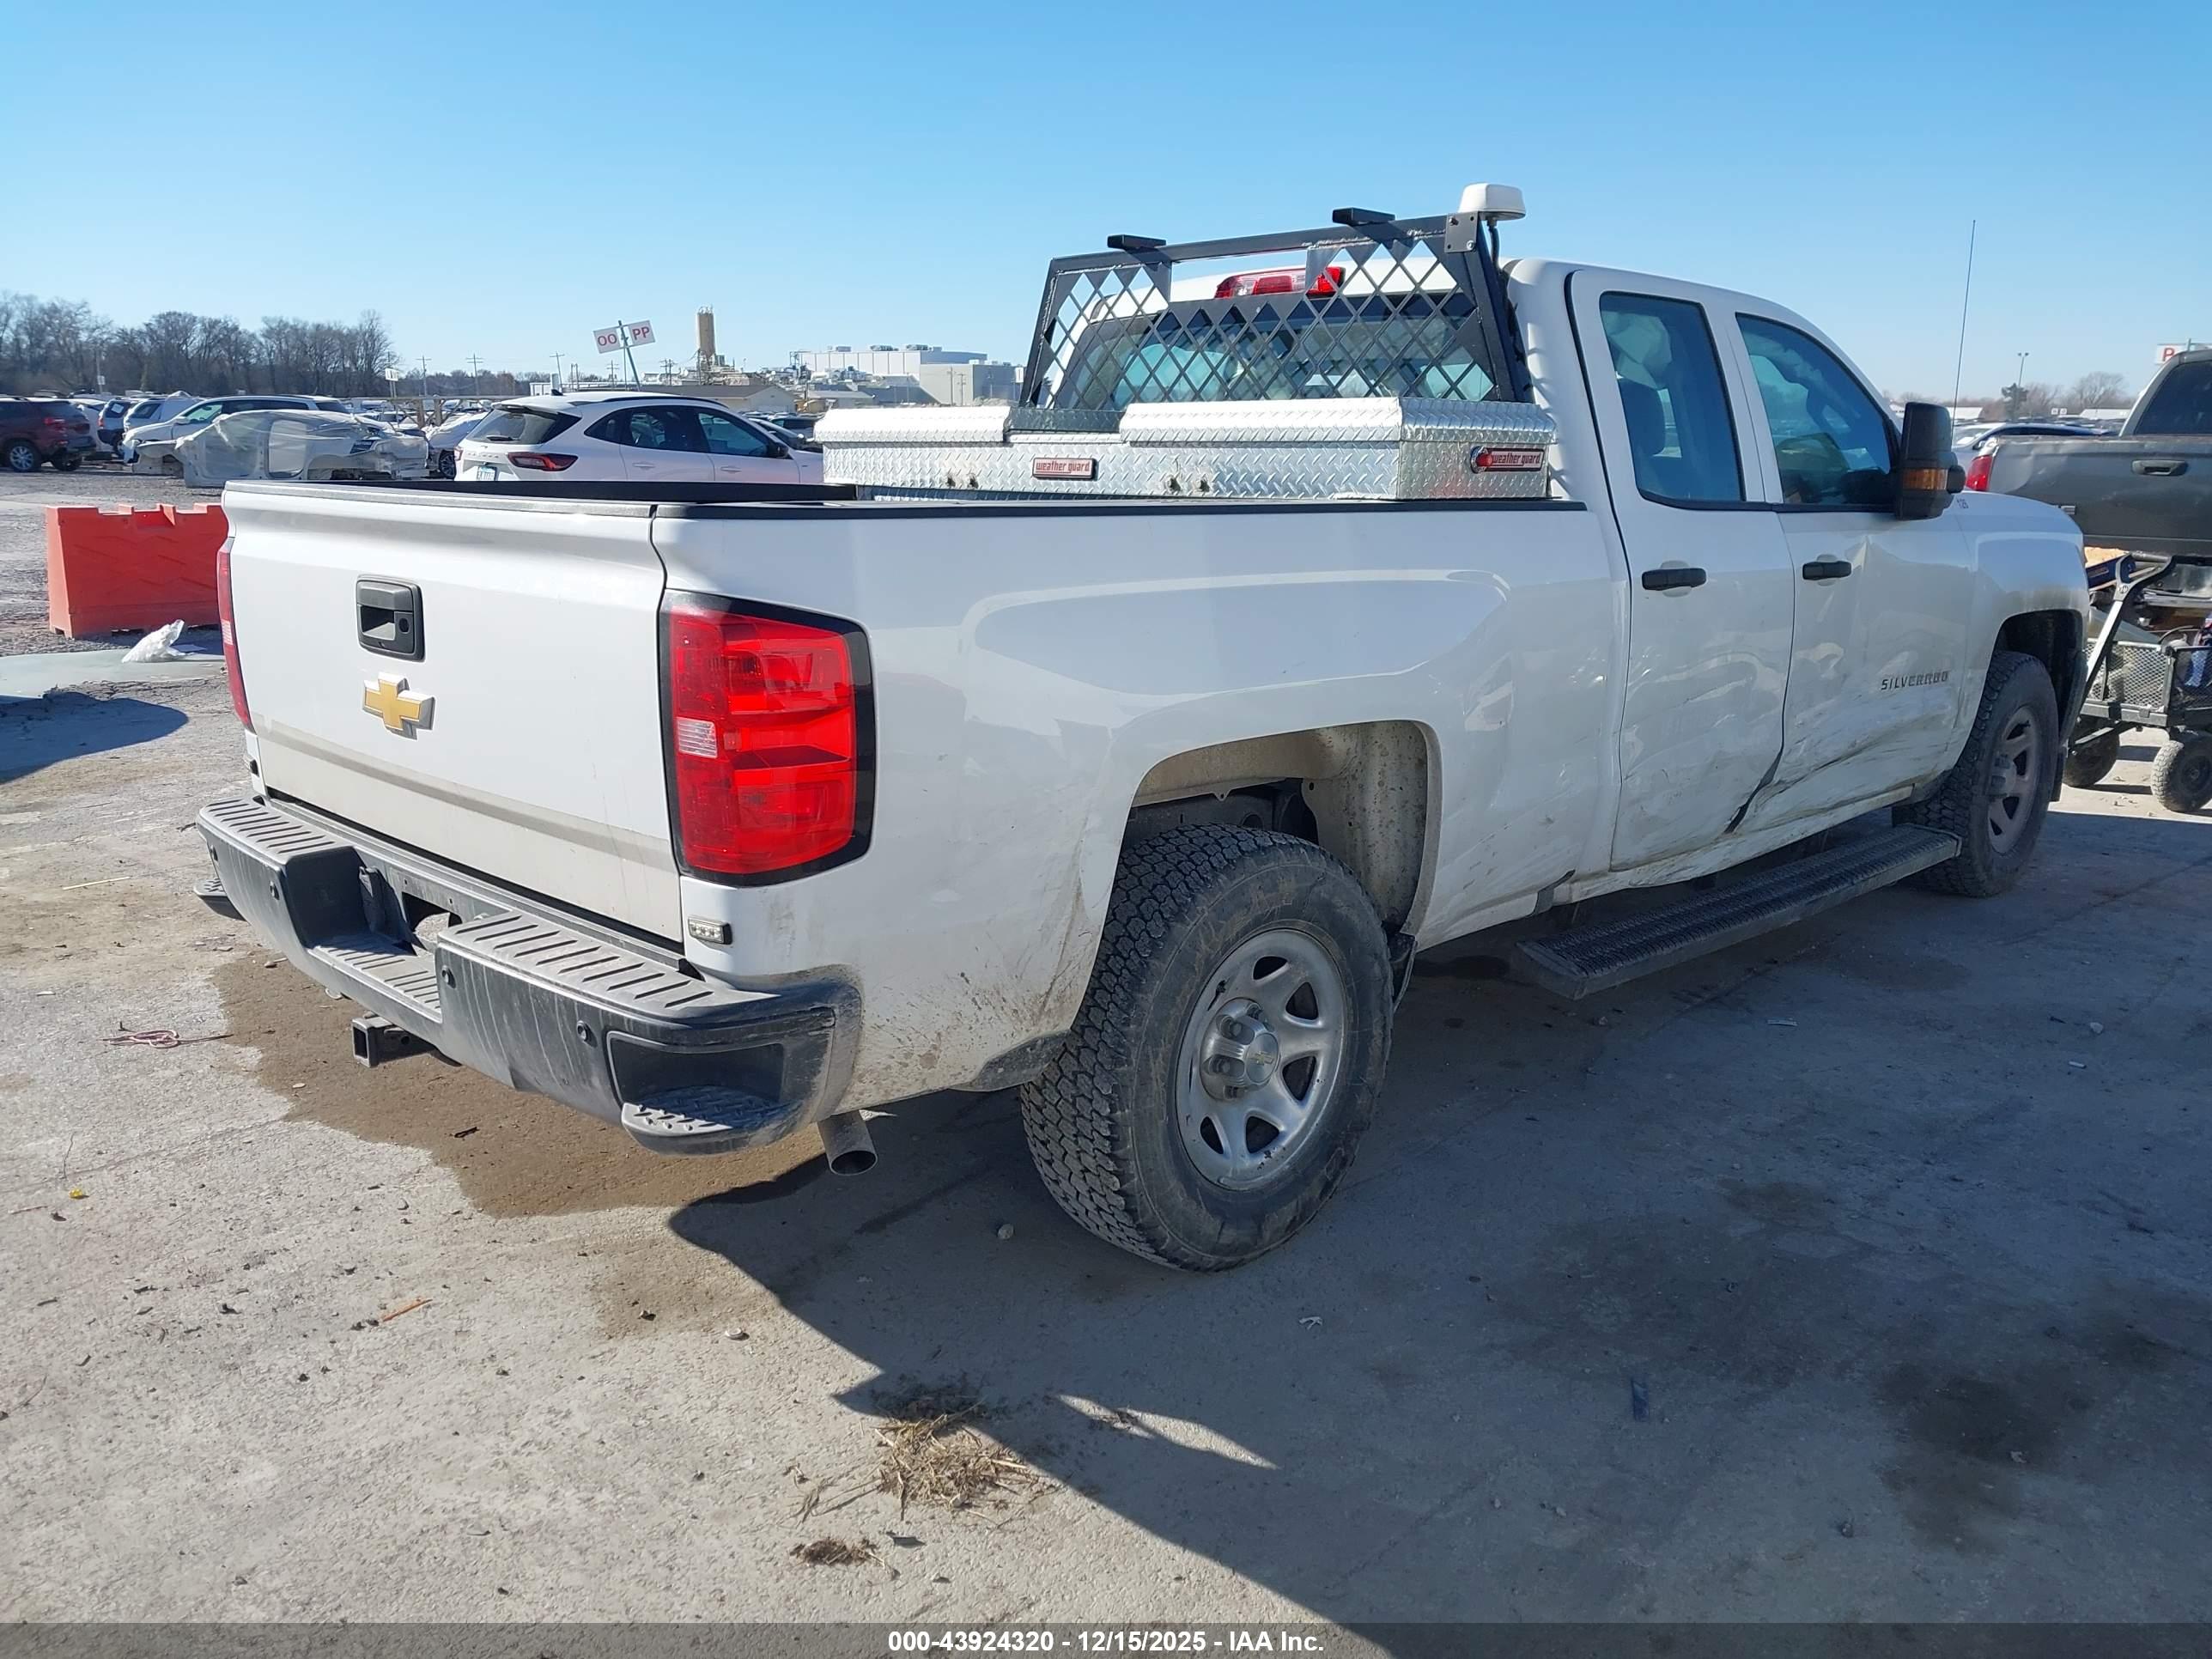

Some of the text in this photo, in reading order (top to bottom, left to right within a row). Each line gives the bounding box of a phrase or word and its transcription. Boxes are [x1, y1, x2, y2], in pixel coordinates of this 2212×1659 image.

[632, 326, 650, 341] PP
[1522, 453, 1542, 465] guard
[1036, 460, 1091, 473] weather guard
[1881, 671, 1949, 690] SILVERADO
